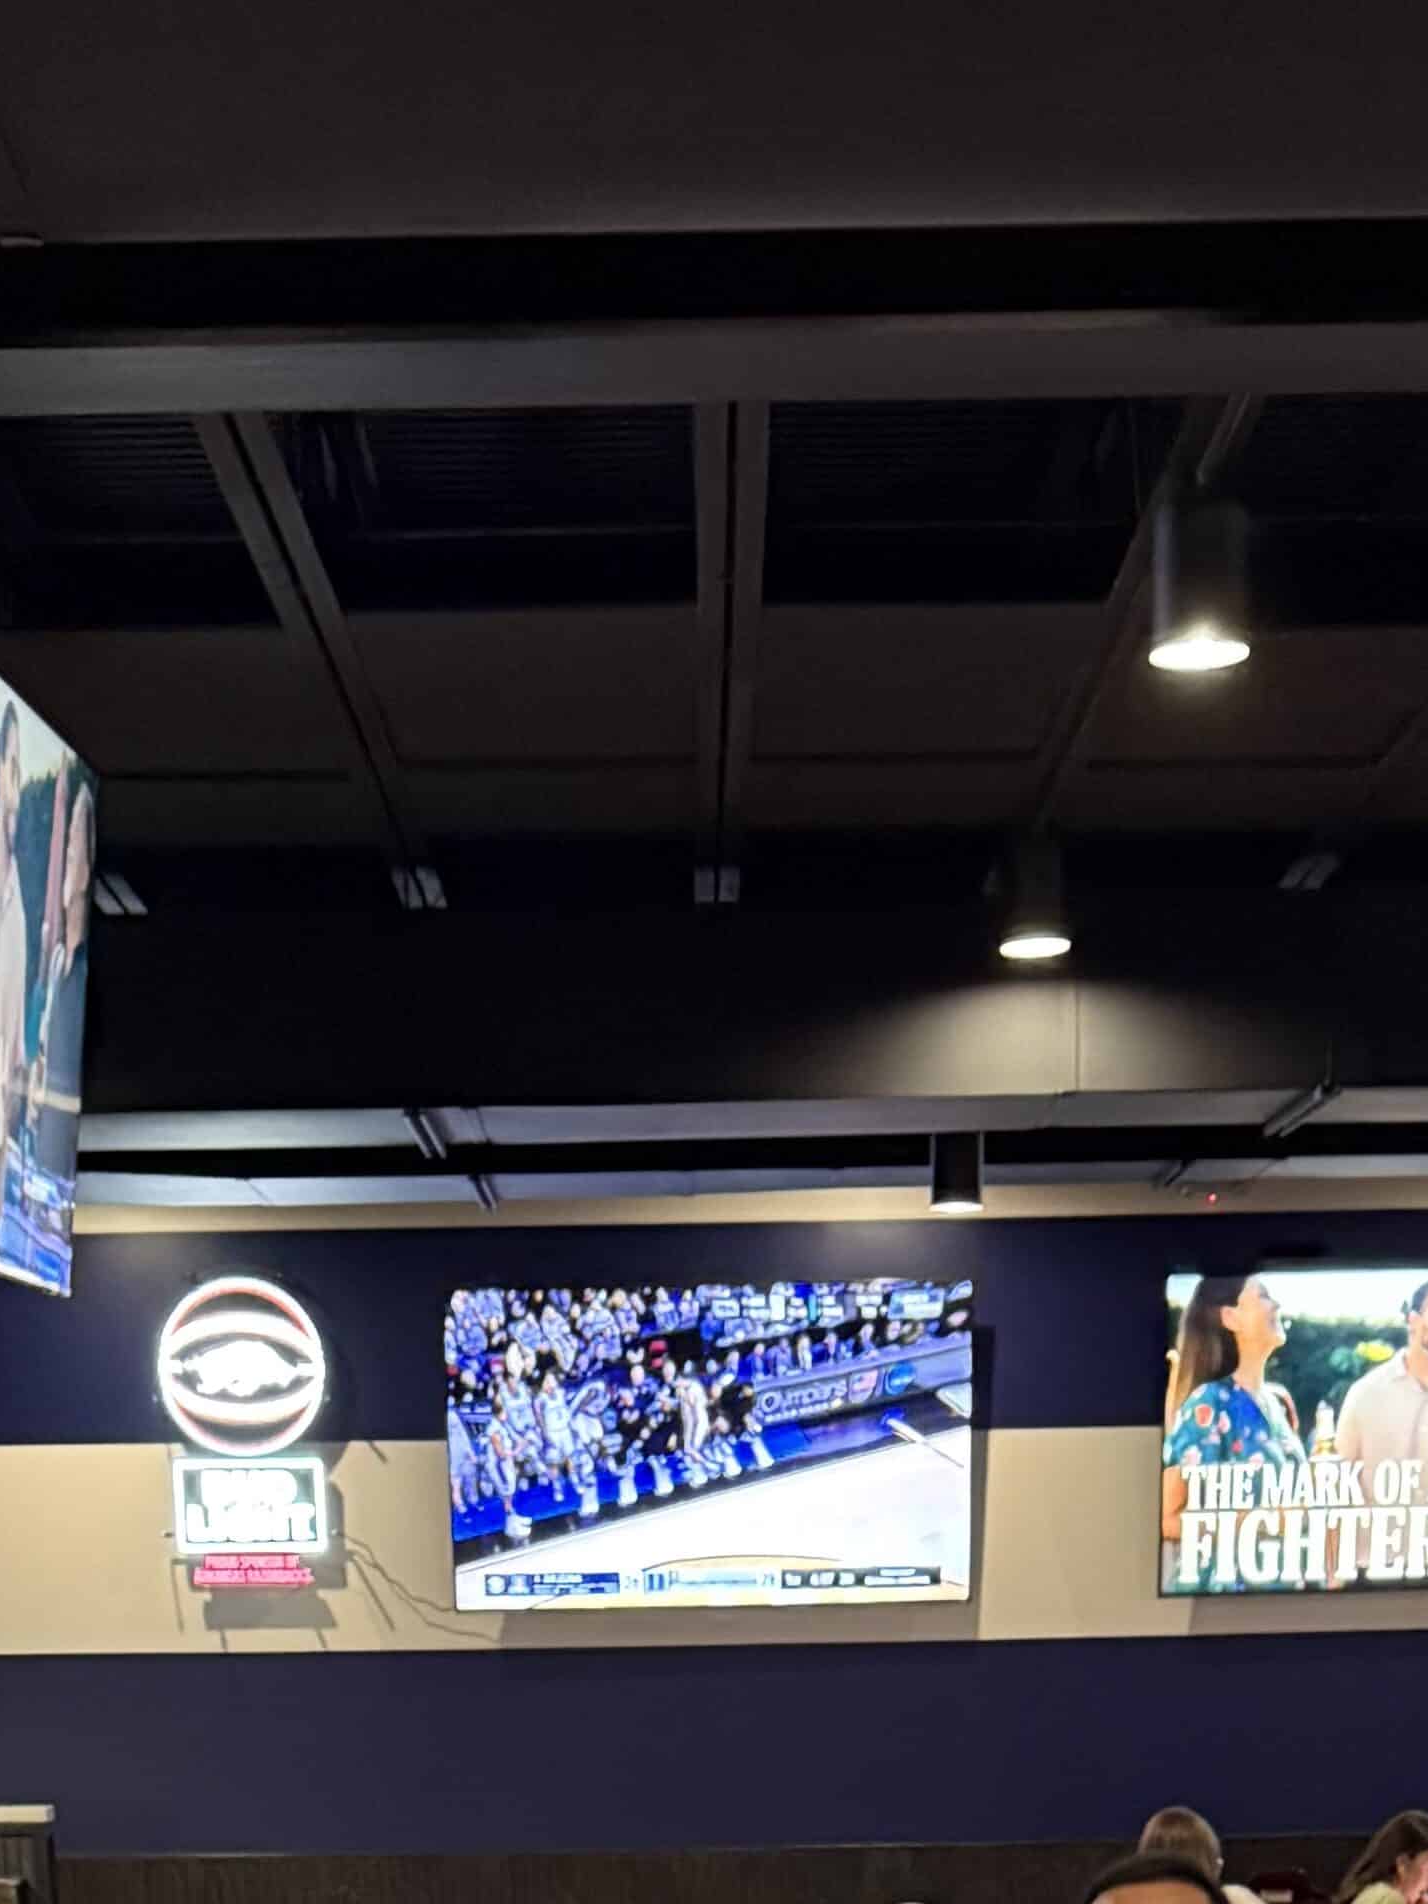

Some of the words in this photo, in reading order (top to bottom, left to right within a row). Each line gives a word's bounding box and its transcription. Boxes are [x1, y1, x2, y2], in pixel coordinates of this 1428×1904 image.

[1181, 1463, 1255, 1510] THE
[1260, 1460, 1365, 1508] MARK
[1374, 1458, 1421, 1505] OF
